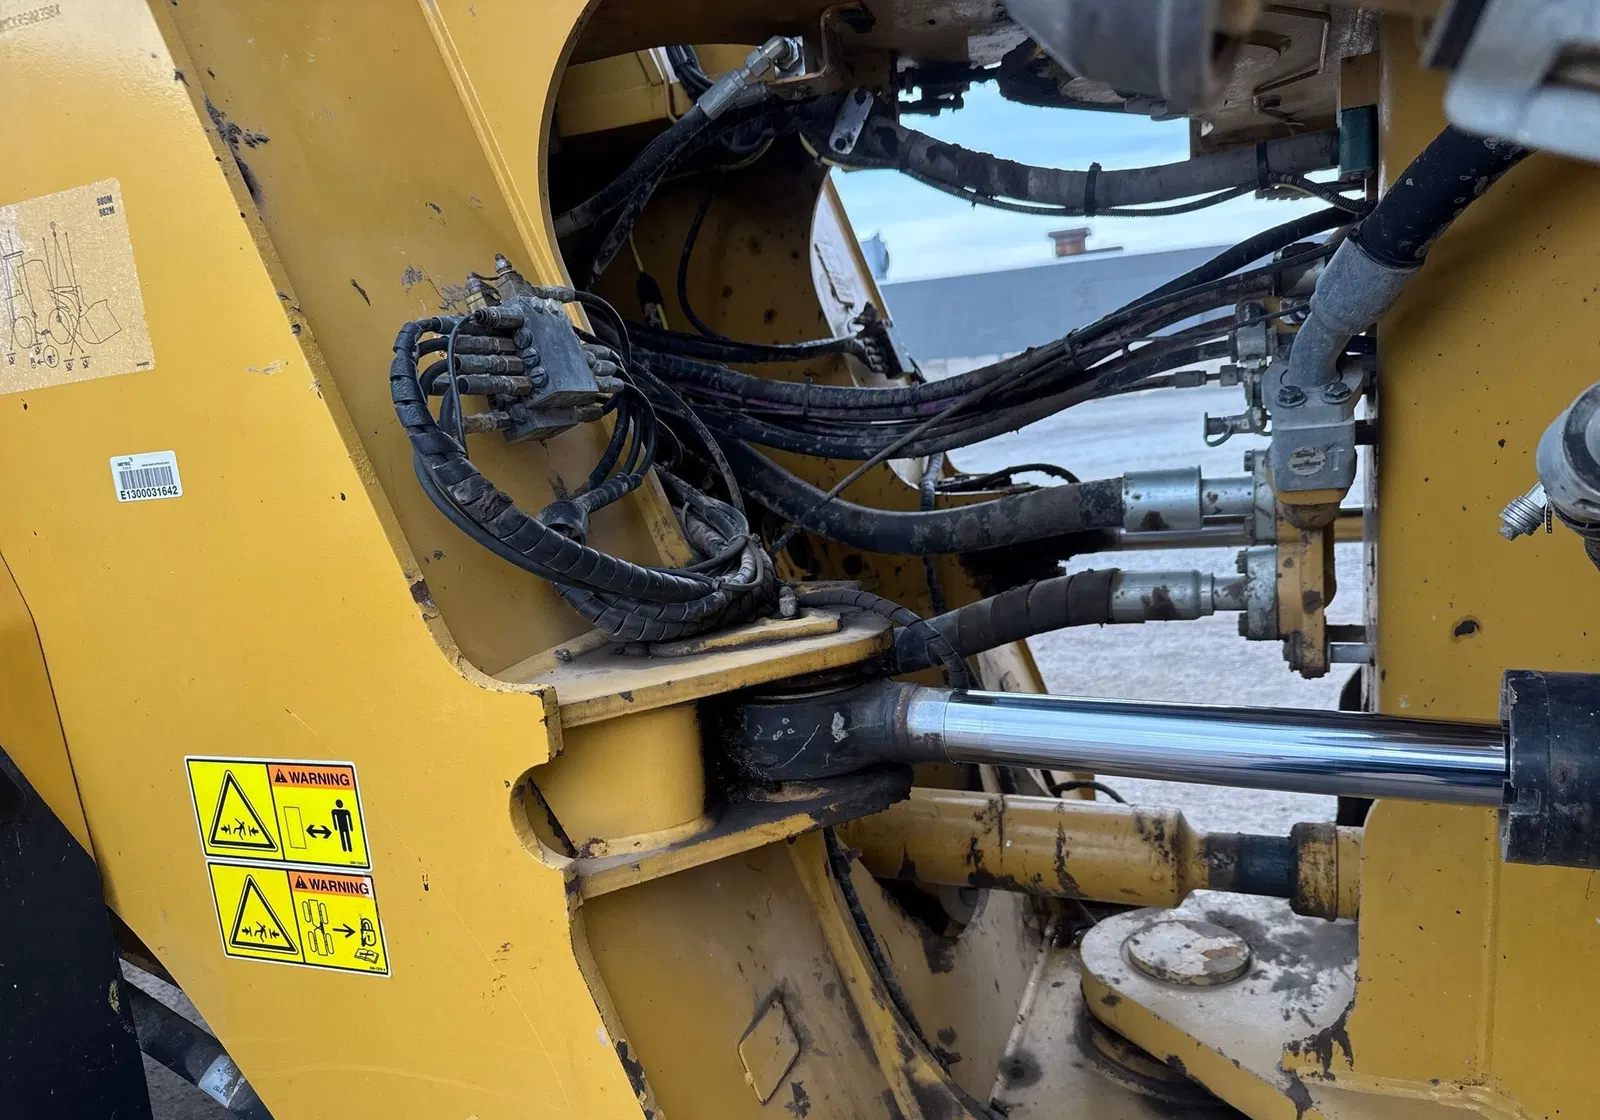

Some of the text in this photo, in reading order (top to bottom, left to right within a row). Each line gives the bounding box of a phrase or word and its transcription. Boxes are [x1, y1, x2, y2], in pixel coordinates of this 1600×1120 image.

[99, 205, 115, 217] 982M
[120, 485, 178, 500] E1300031642
[288, 771, 350, 786] WARNING
[308, 878, 370, 895] WARNING
